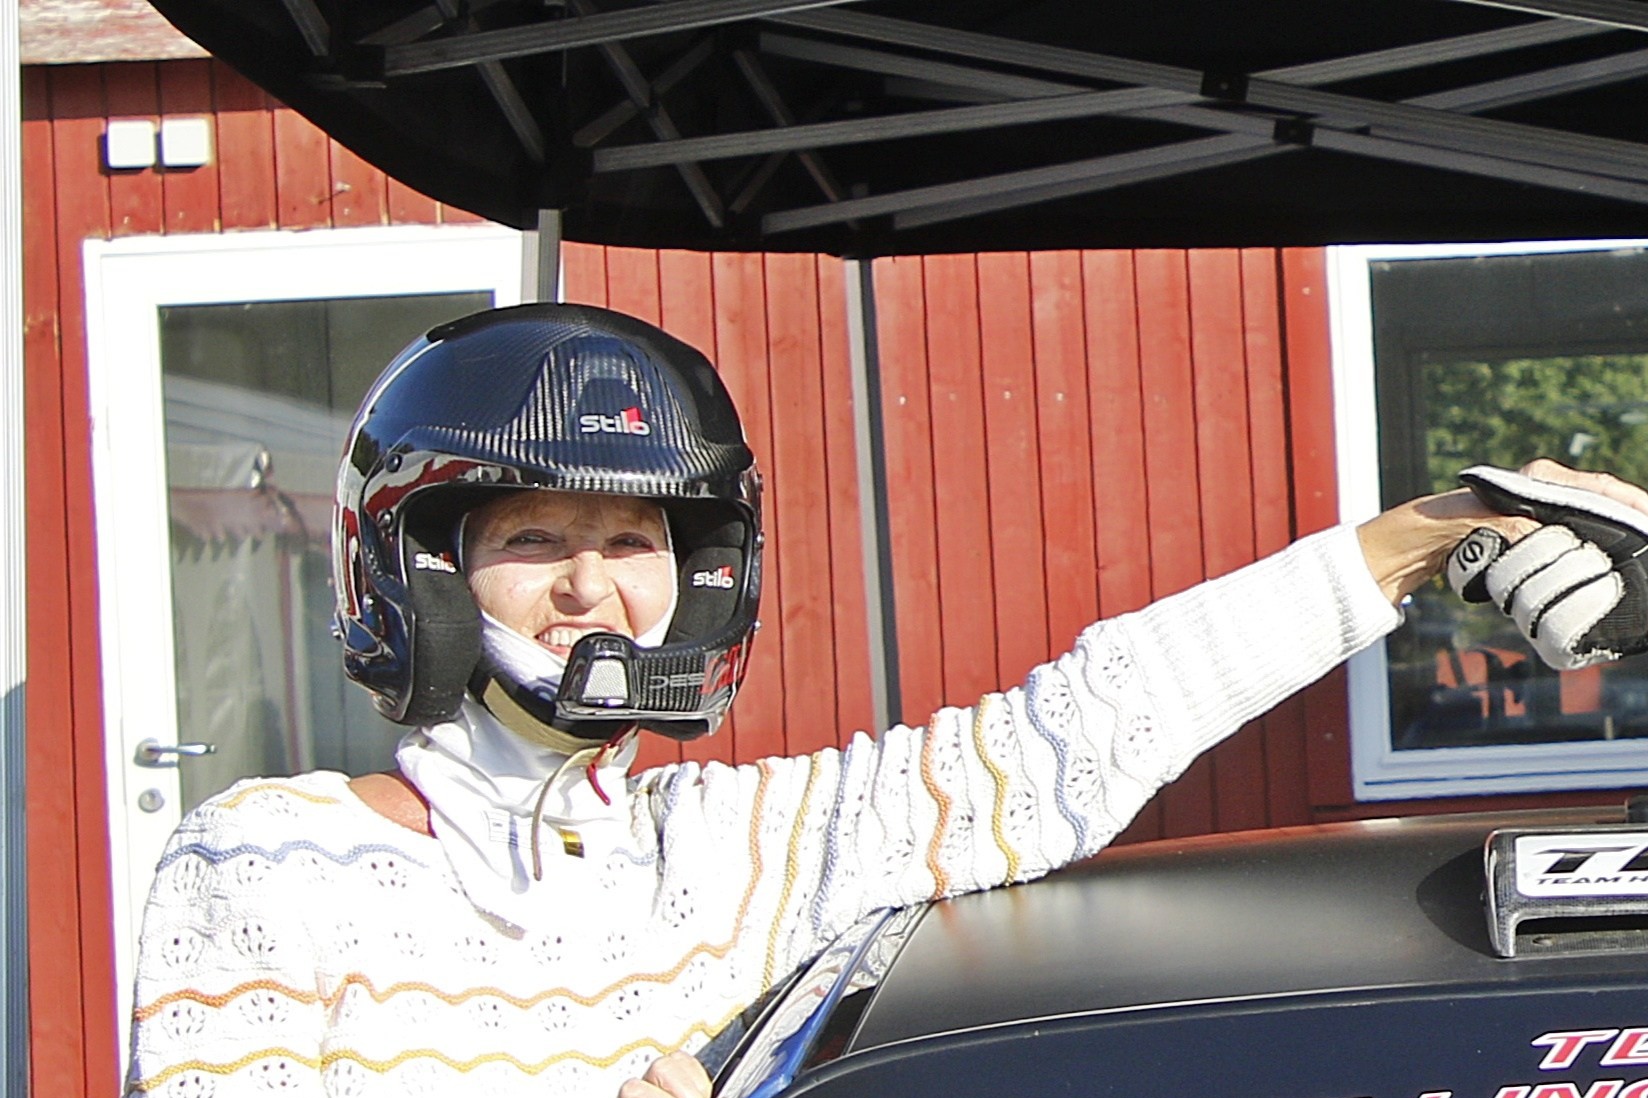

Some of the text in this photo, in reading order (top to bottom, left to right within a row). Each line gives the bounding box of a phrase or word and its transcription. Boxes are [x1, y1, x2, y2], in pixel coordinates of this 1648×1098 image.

[580, 406, 650, 436] Stilo
[415, 552, 456, 574] Stilo
[693, 566, 734, 589] Stilo
[1536, 875, 1622, 886] TEAM
